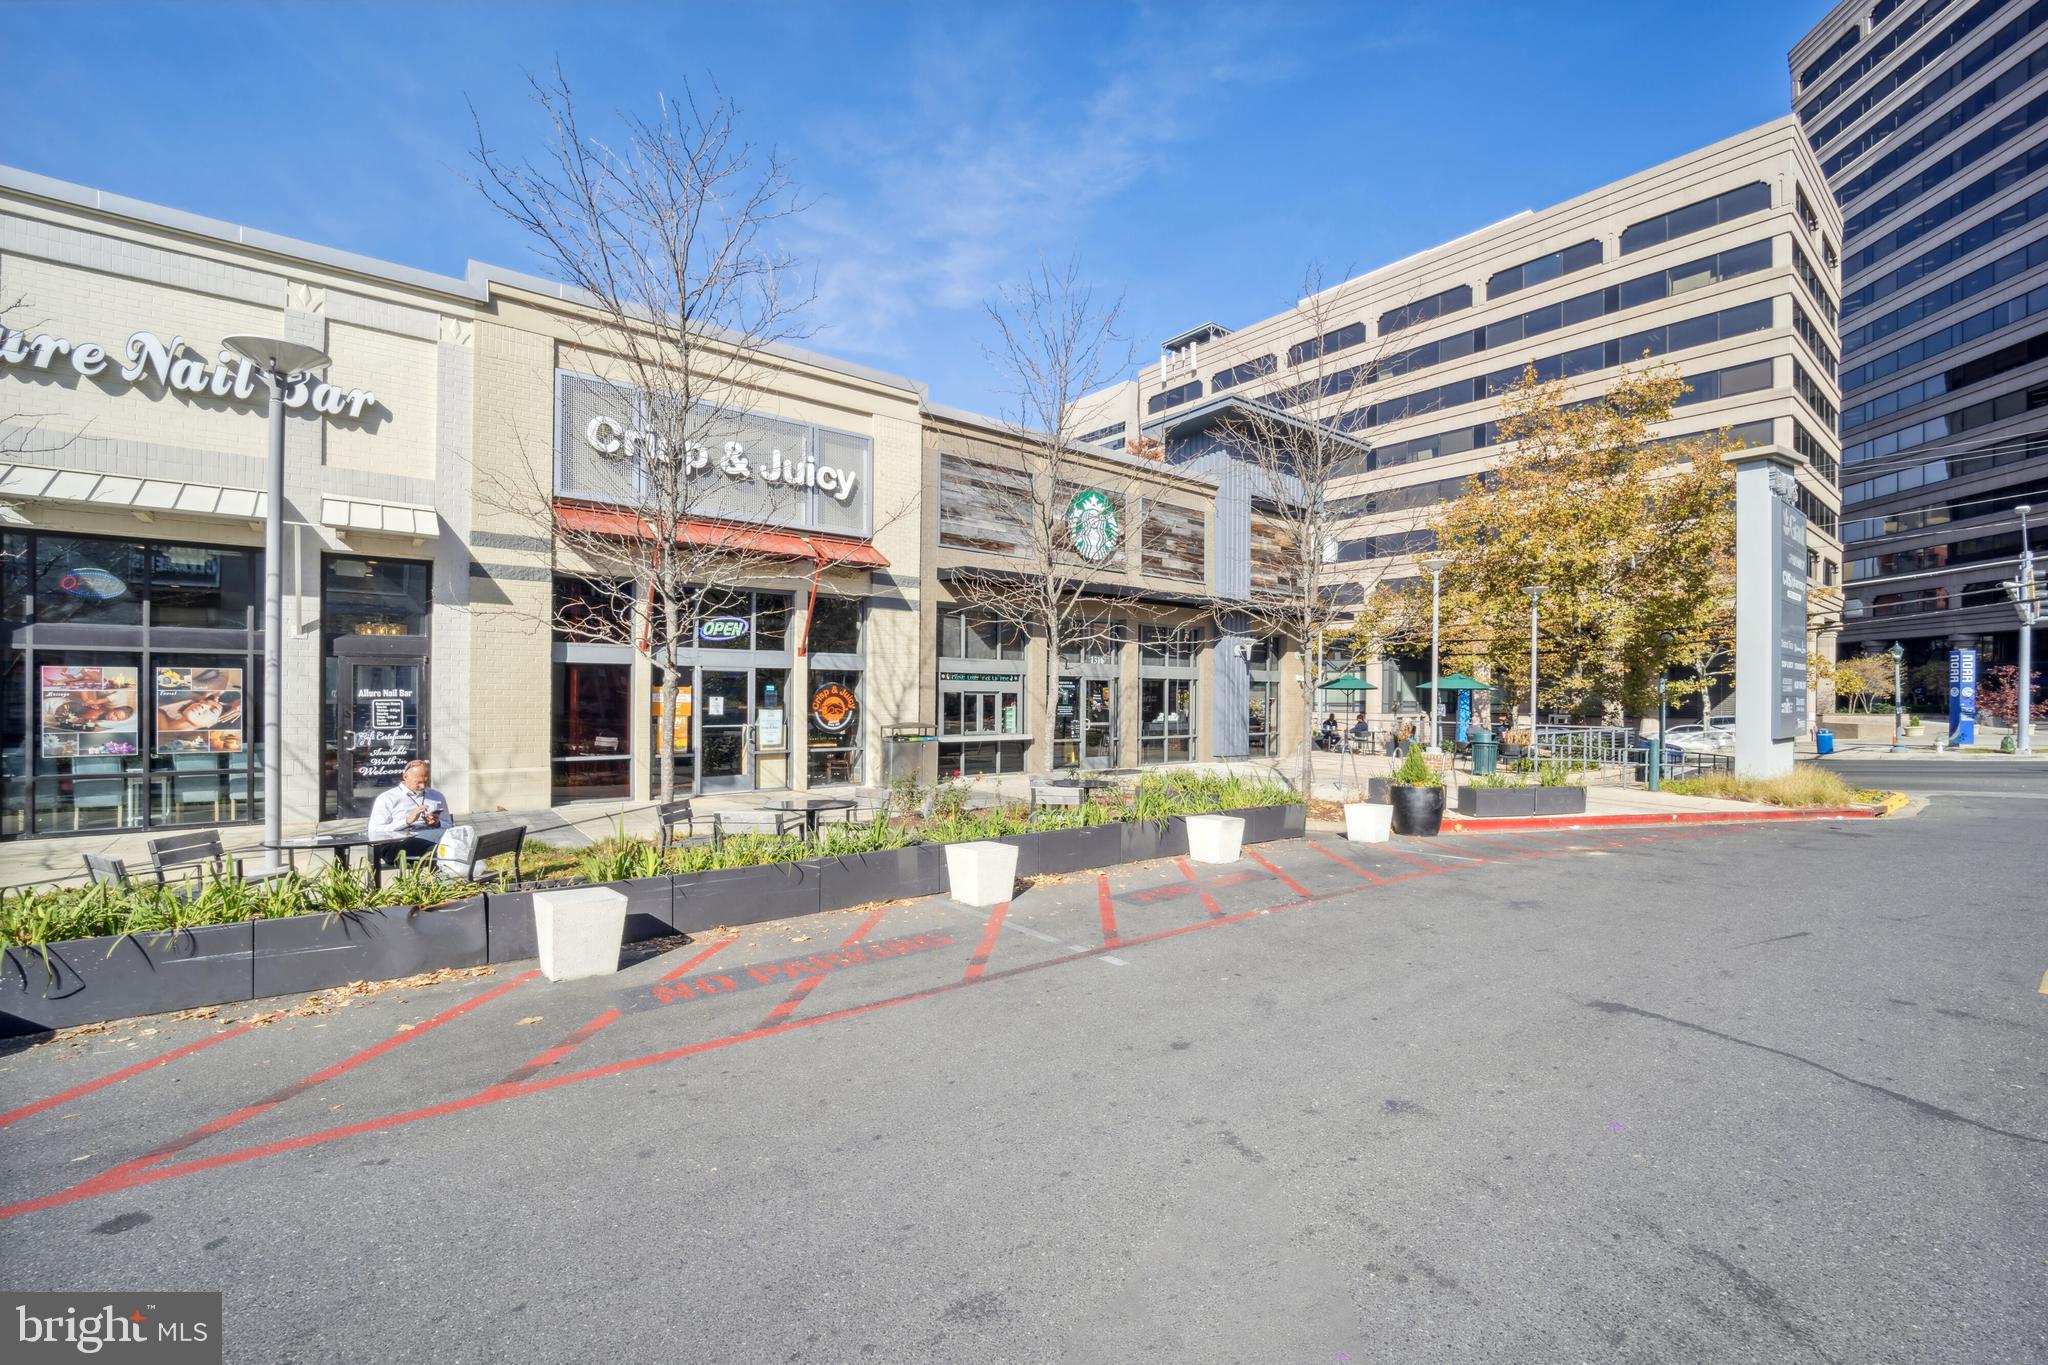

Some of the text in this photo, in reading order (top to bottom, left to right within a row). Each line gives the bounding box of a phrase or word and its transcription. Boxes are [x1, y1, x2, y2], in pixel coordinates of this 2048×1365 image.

[121, 331, 255, 400] Nail
[720, 441, 751, 476] &
[759, 448, 857, 500] Juicy
[703, 621, 744, 636] OPEN
[358, 689, 412, 697] Allure Nail Bar
[812, 685, 856, 710] Crisp & Juicy
[358, 731, 375, 745] Gift
[370, 745, 407, 757] Available
[370, 756, 396, 765] Walk
[359, 766, 406, 776] Welcom
[653, 931, 954, 1004] NO PARKING
